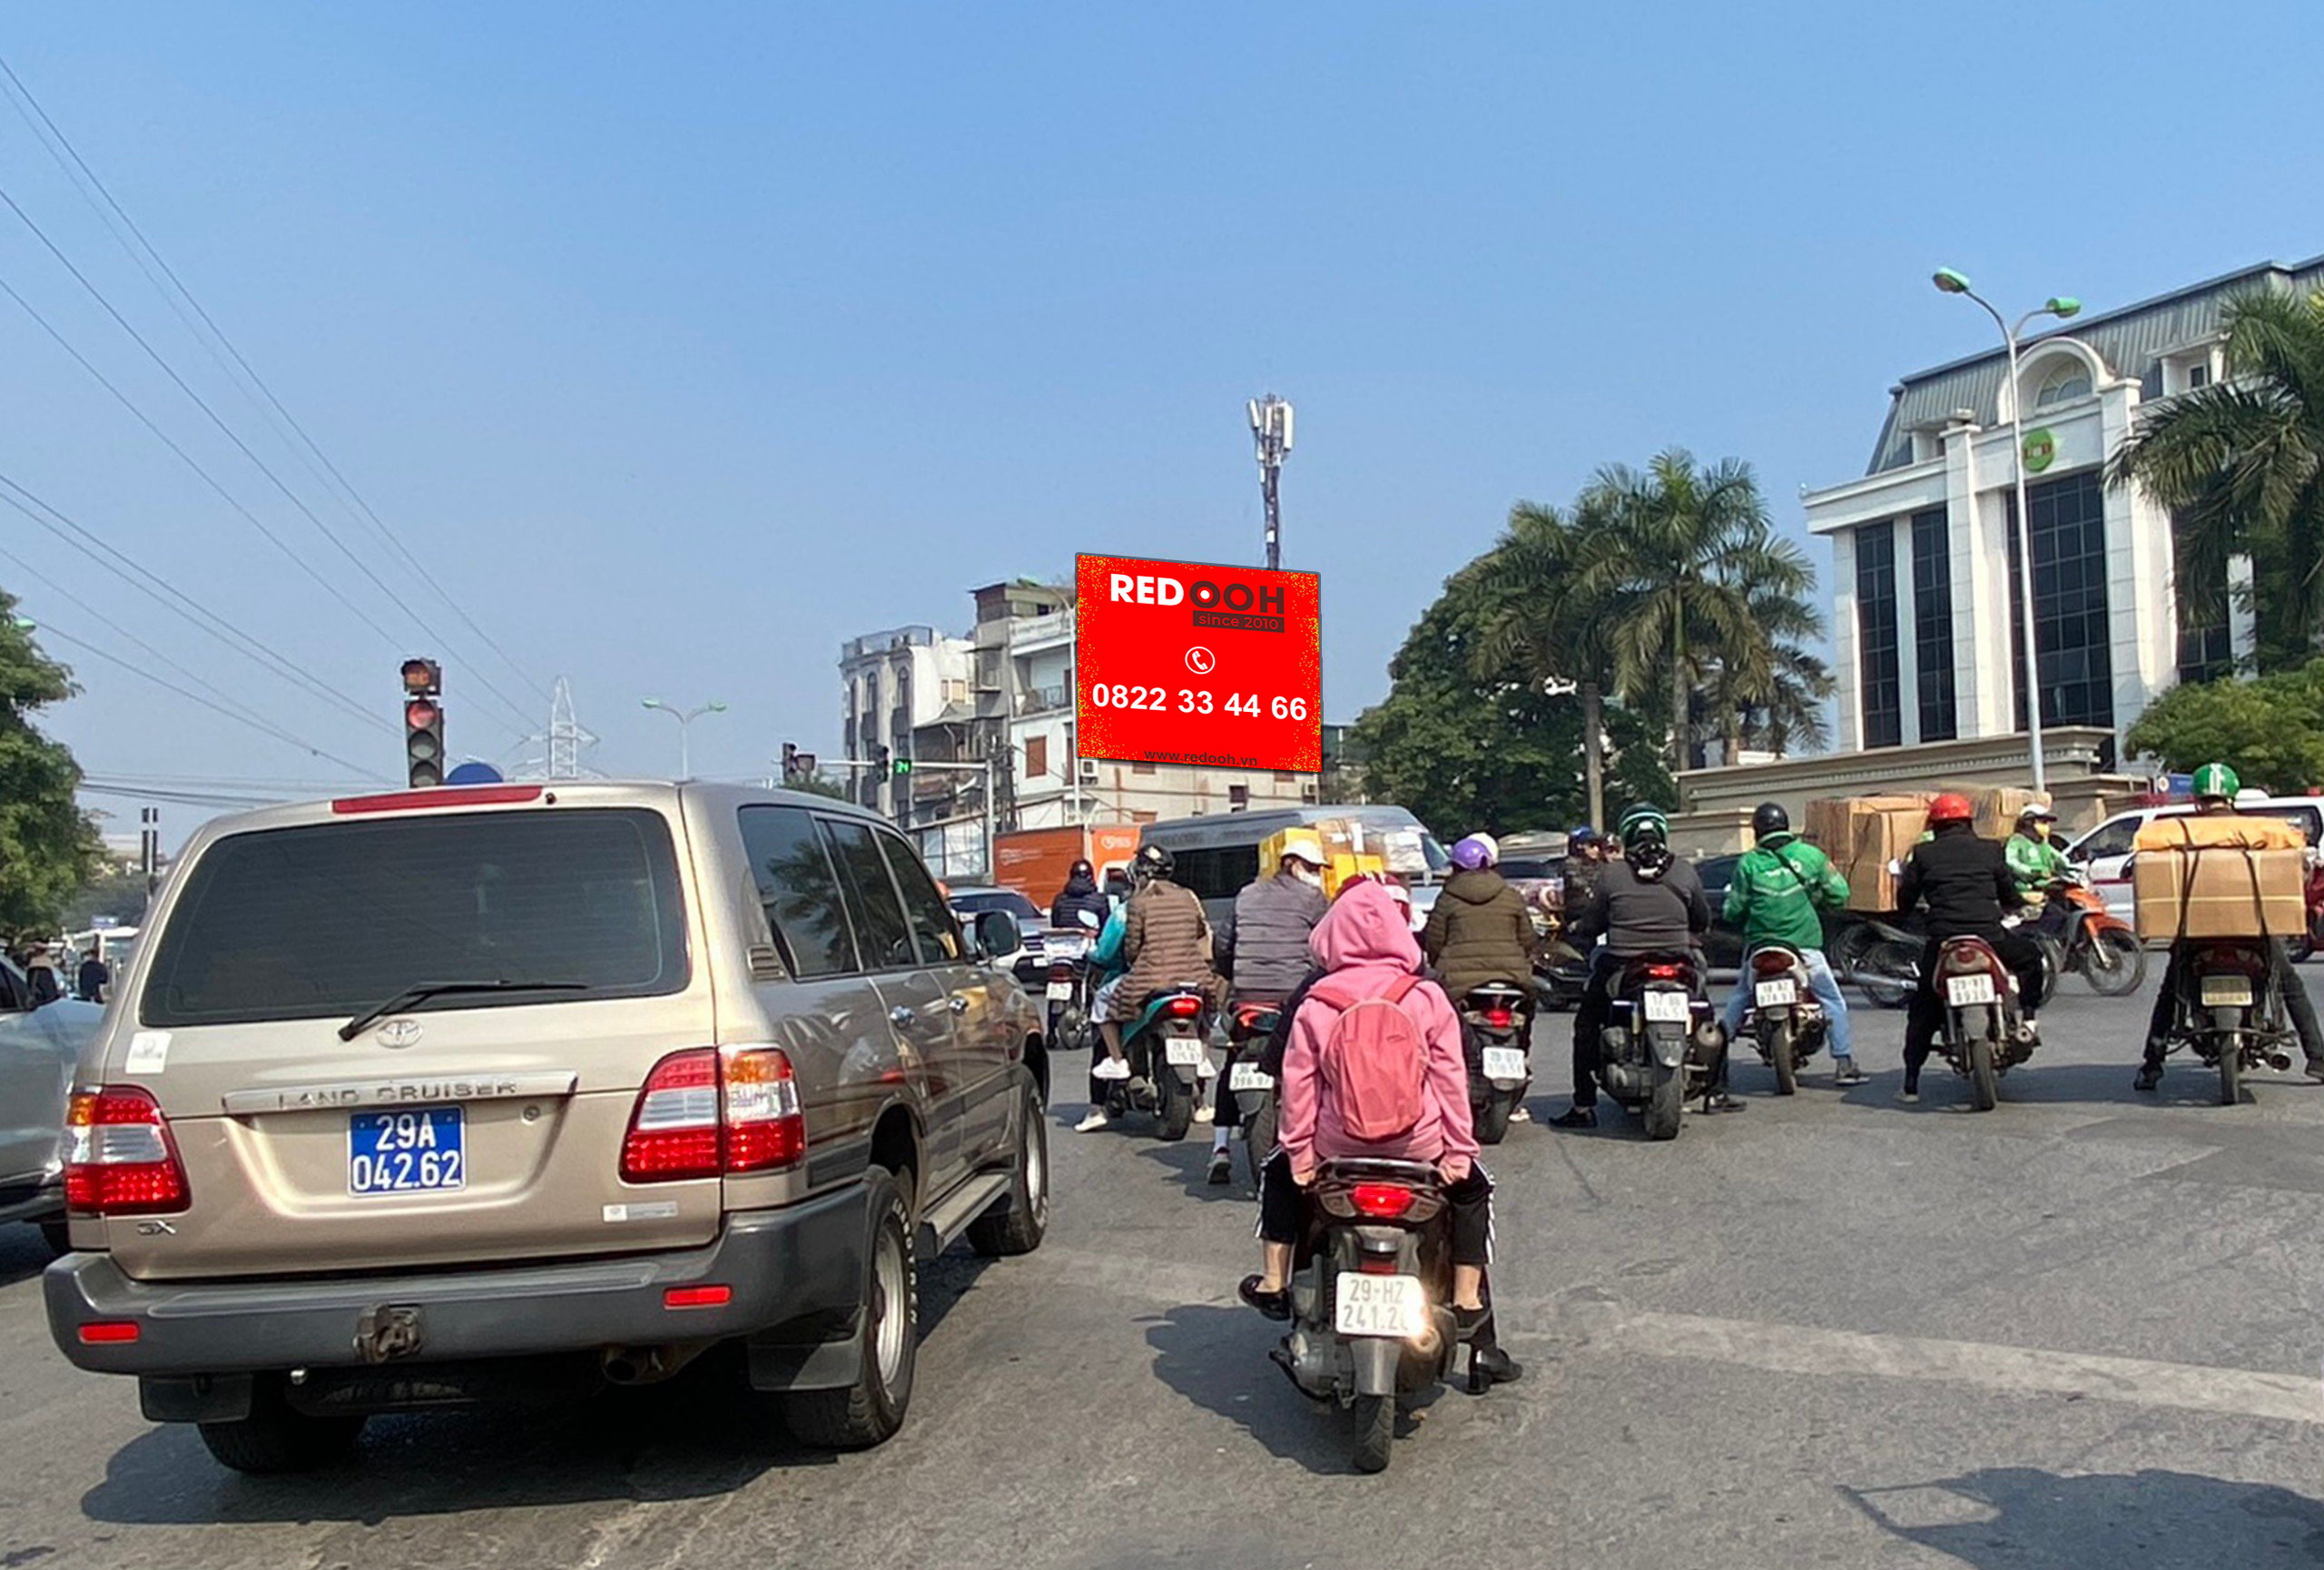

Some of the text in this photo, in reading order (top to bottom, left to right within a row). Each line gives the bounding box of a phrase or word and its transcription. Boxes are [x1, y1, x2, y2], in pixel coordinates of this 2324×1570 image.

[1110, 573, 1285, 615] RED OOH
[1197, 613, 1279, 630] since 2010
[1092, 683, 1307, 721] 0822 33 44 66
[1144, 750, 1258, 766] www.redooh.vn
[279, 1082, 517, 1109] LAND CRUISER
[376, 1112, 437, 1150] 29A
[352, 1150, 461, 1191] 042.62
